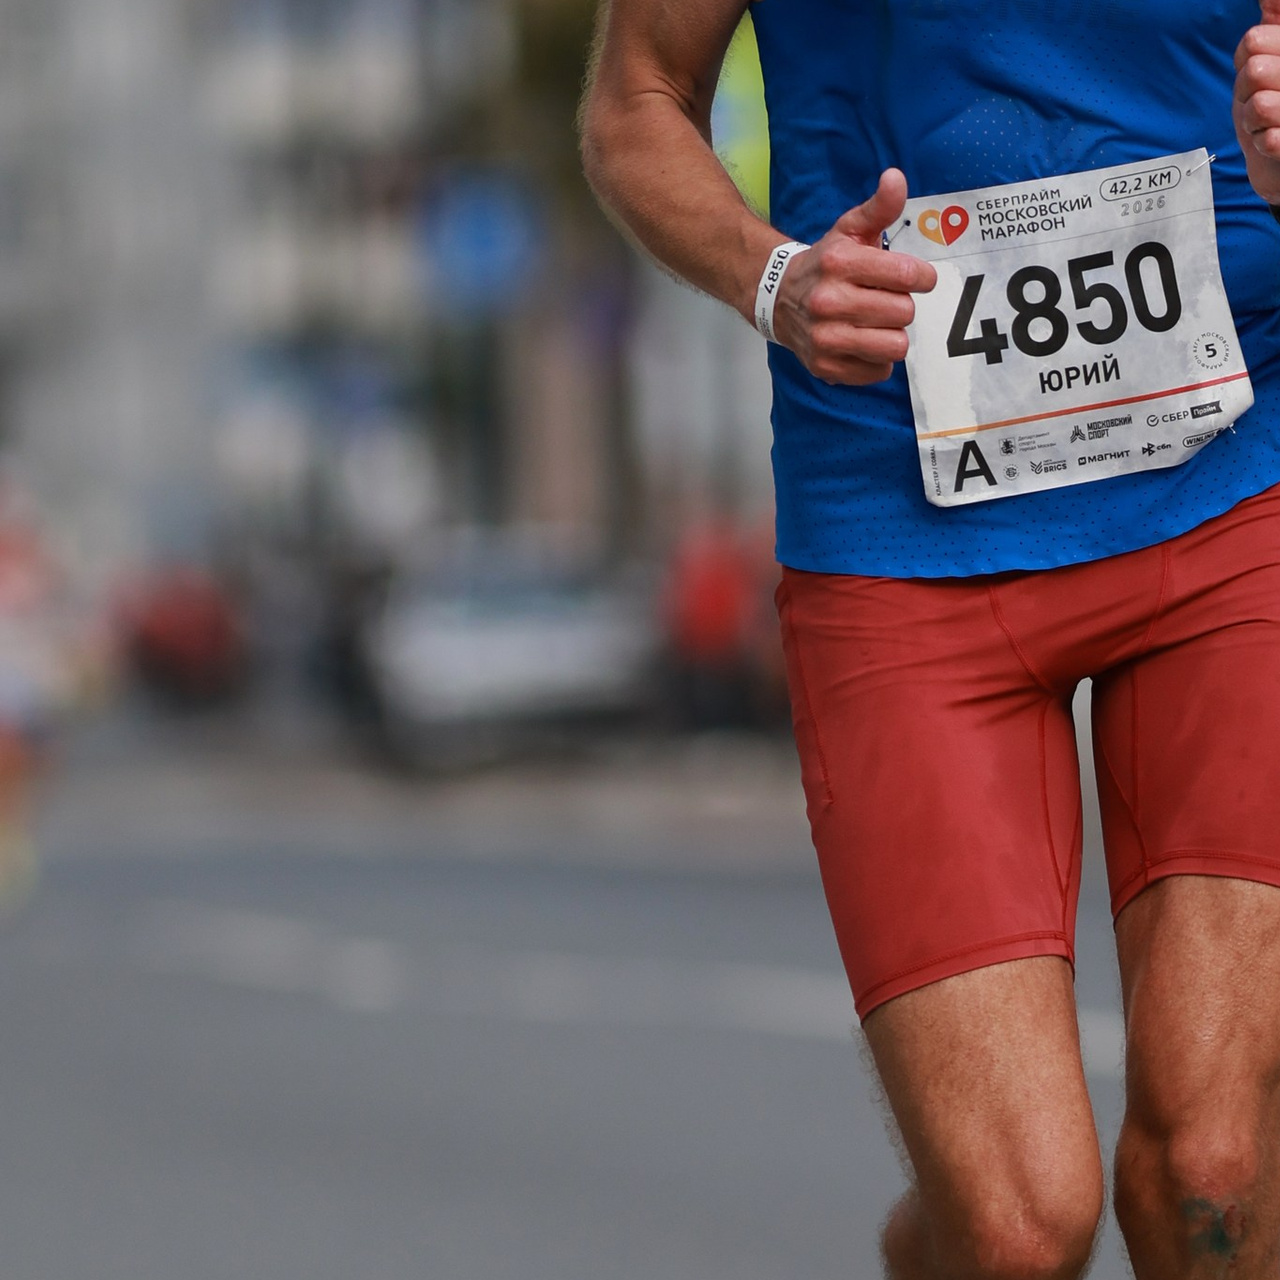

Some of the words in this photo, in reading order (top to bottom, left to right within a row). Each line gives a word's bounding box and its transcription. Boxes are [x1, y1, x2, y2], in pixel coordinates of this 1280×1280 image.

[1109, 176, 1142, 197] 42,2
[1147, 170, 1173, 189] КМ
[976, 188, 1061, 211] СБЕРПРАЙМ
[978, 195, 1093, 227] МОСКОВСКИЙ
[1121, 194, 1166, 217] 2026
[980, 216, 1066, 241] МАРАФОН
[764, 249, 789, 295] 4850
[946, 241, 1182, 365] 4850
[1204, 342, 1217, 358] 5
[1039, 353, 1121, 394] ЮРИЙ
[1087, 414, 1132, 431] МОСКОВСКИЙ
[1161, 410, 1189, 423] СБЕР
[1088, 428, 1109, 440] СПОРТ
[1043, 463, 1067, 473] BRICS
